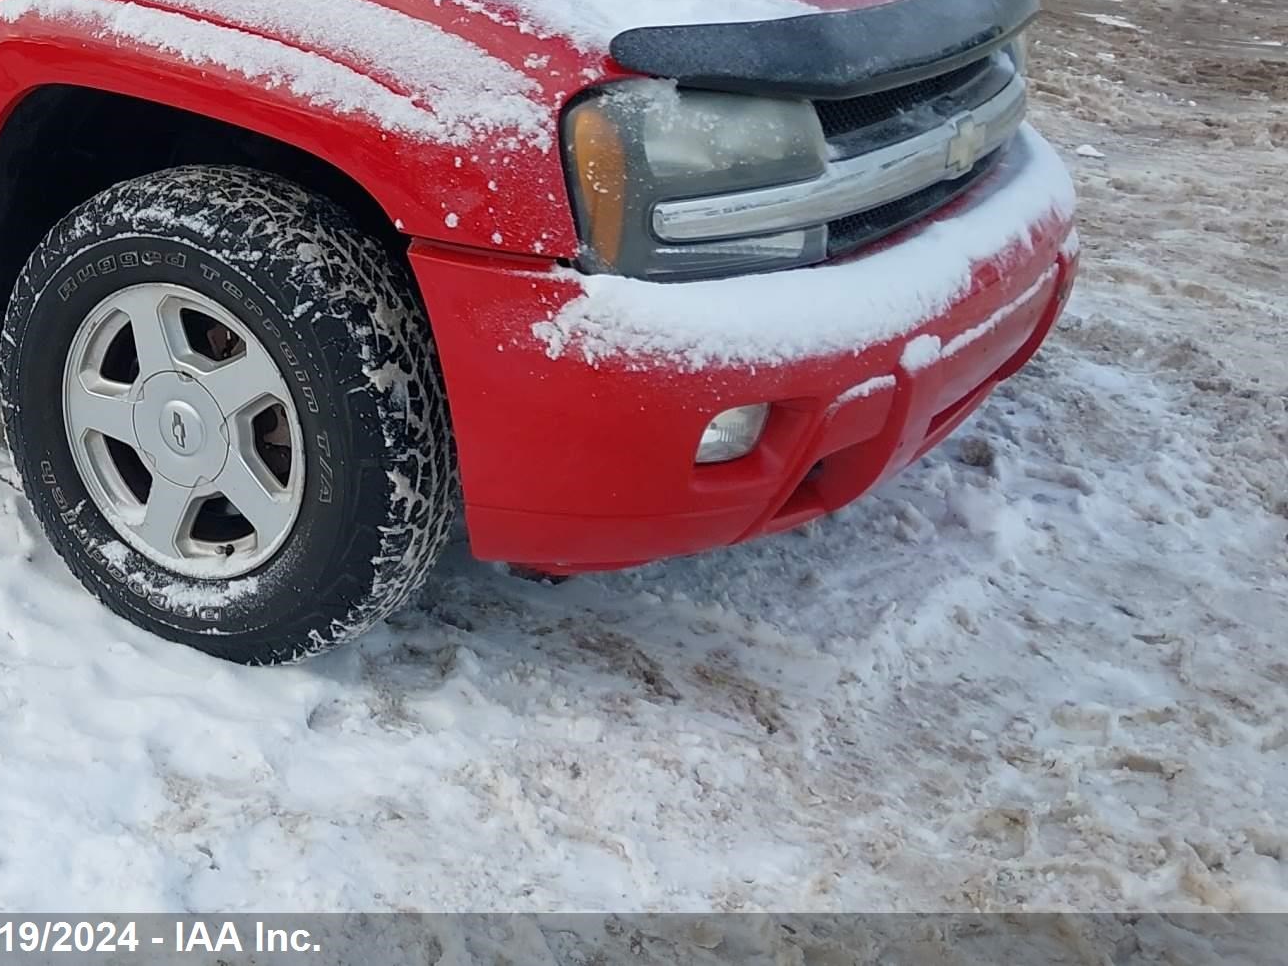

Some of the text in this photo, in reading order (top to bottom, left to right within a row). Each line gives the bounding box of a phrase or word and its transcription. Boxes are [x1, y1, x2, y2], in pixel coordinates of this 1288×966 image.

[58, 250, 333, 504] Rugged Terrain T/A
